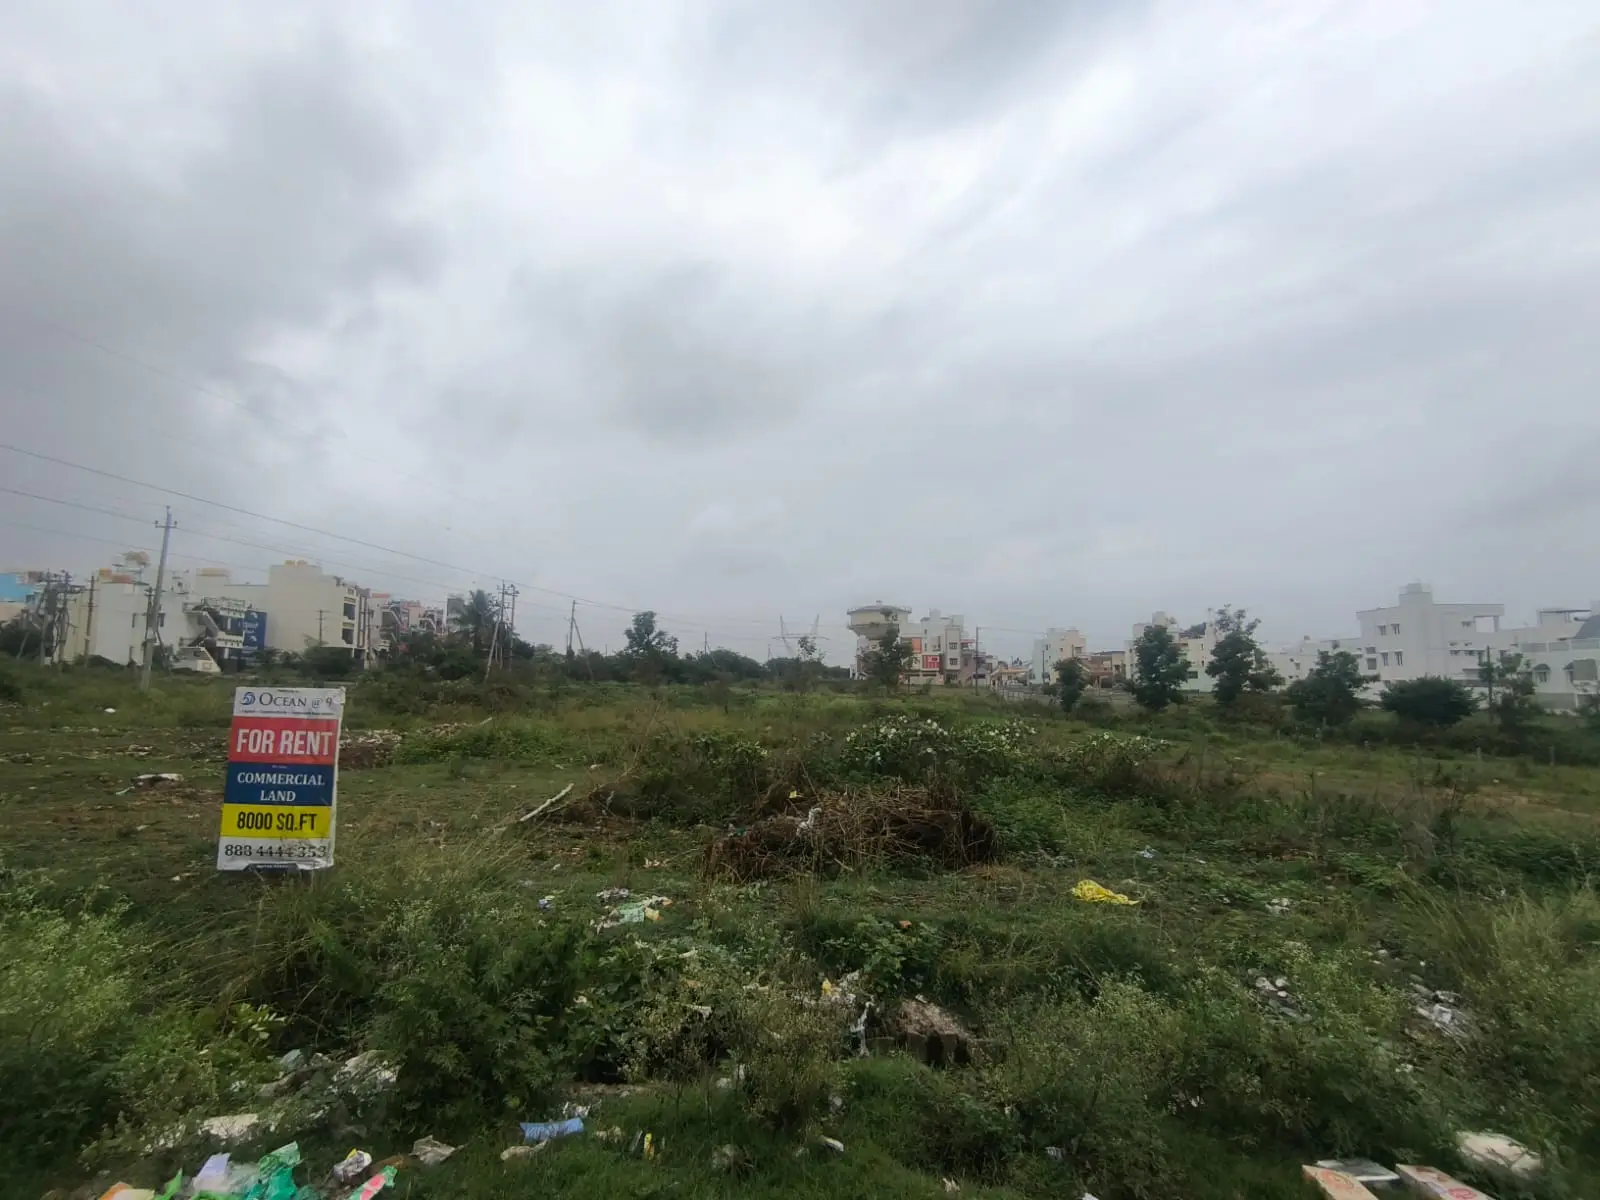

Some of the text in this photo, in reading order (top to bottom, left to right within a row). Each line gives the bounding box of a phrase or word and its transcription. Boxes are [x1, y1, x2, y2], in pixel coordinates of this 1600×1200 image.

[259, 692, 307, 707] OCEAN
[236, 728, 333, 756] FOR RENT
[237, 771, 326, 786] COMMERCIAL
[260, 790, 296, 802] LAND
[237, 811, 317, 832] 8000 SQ.FT
